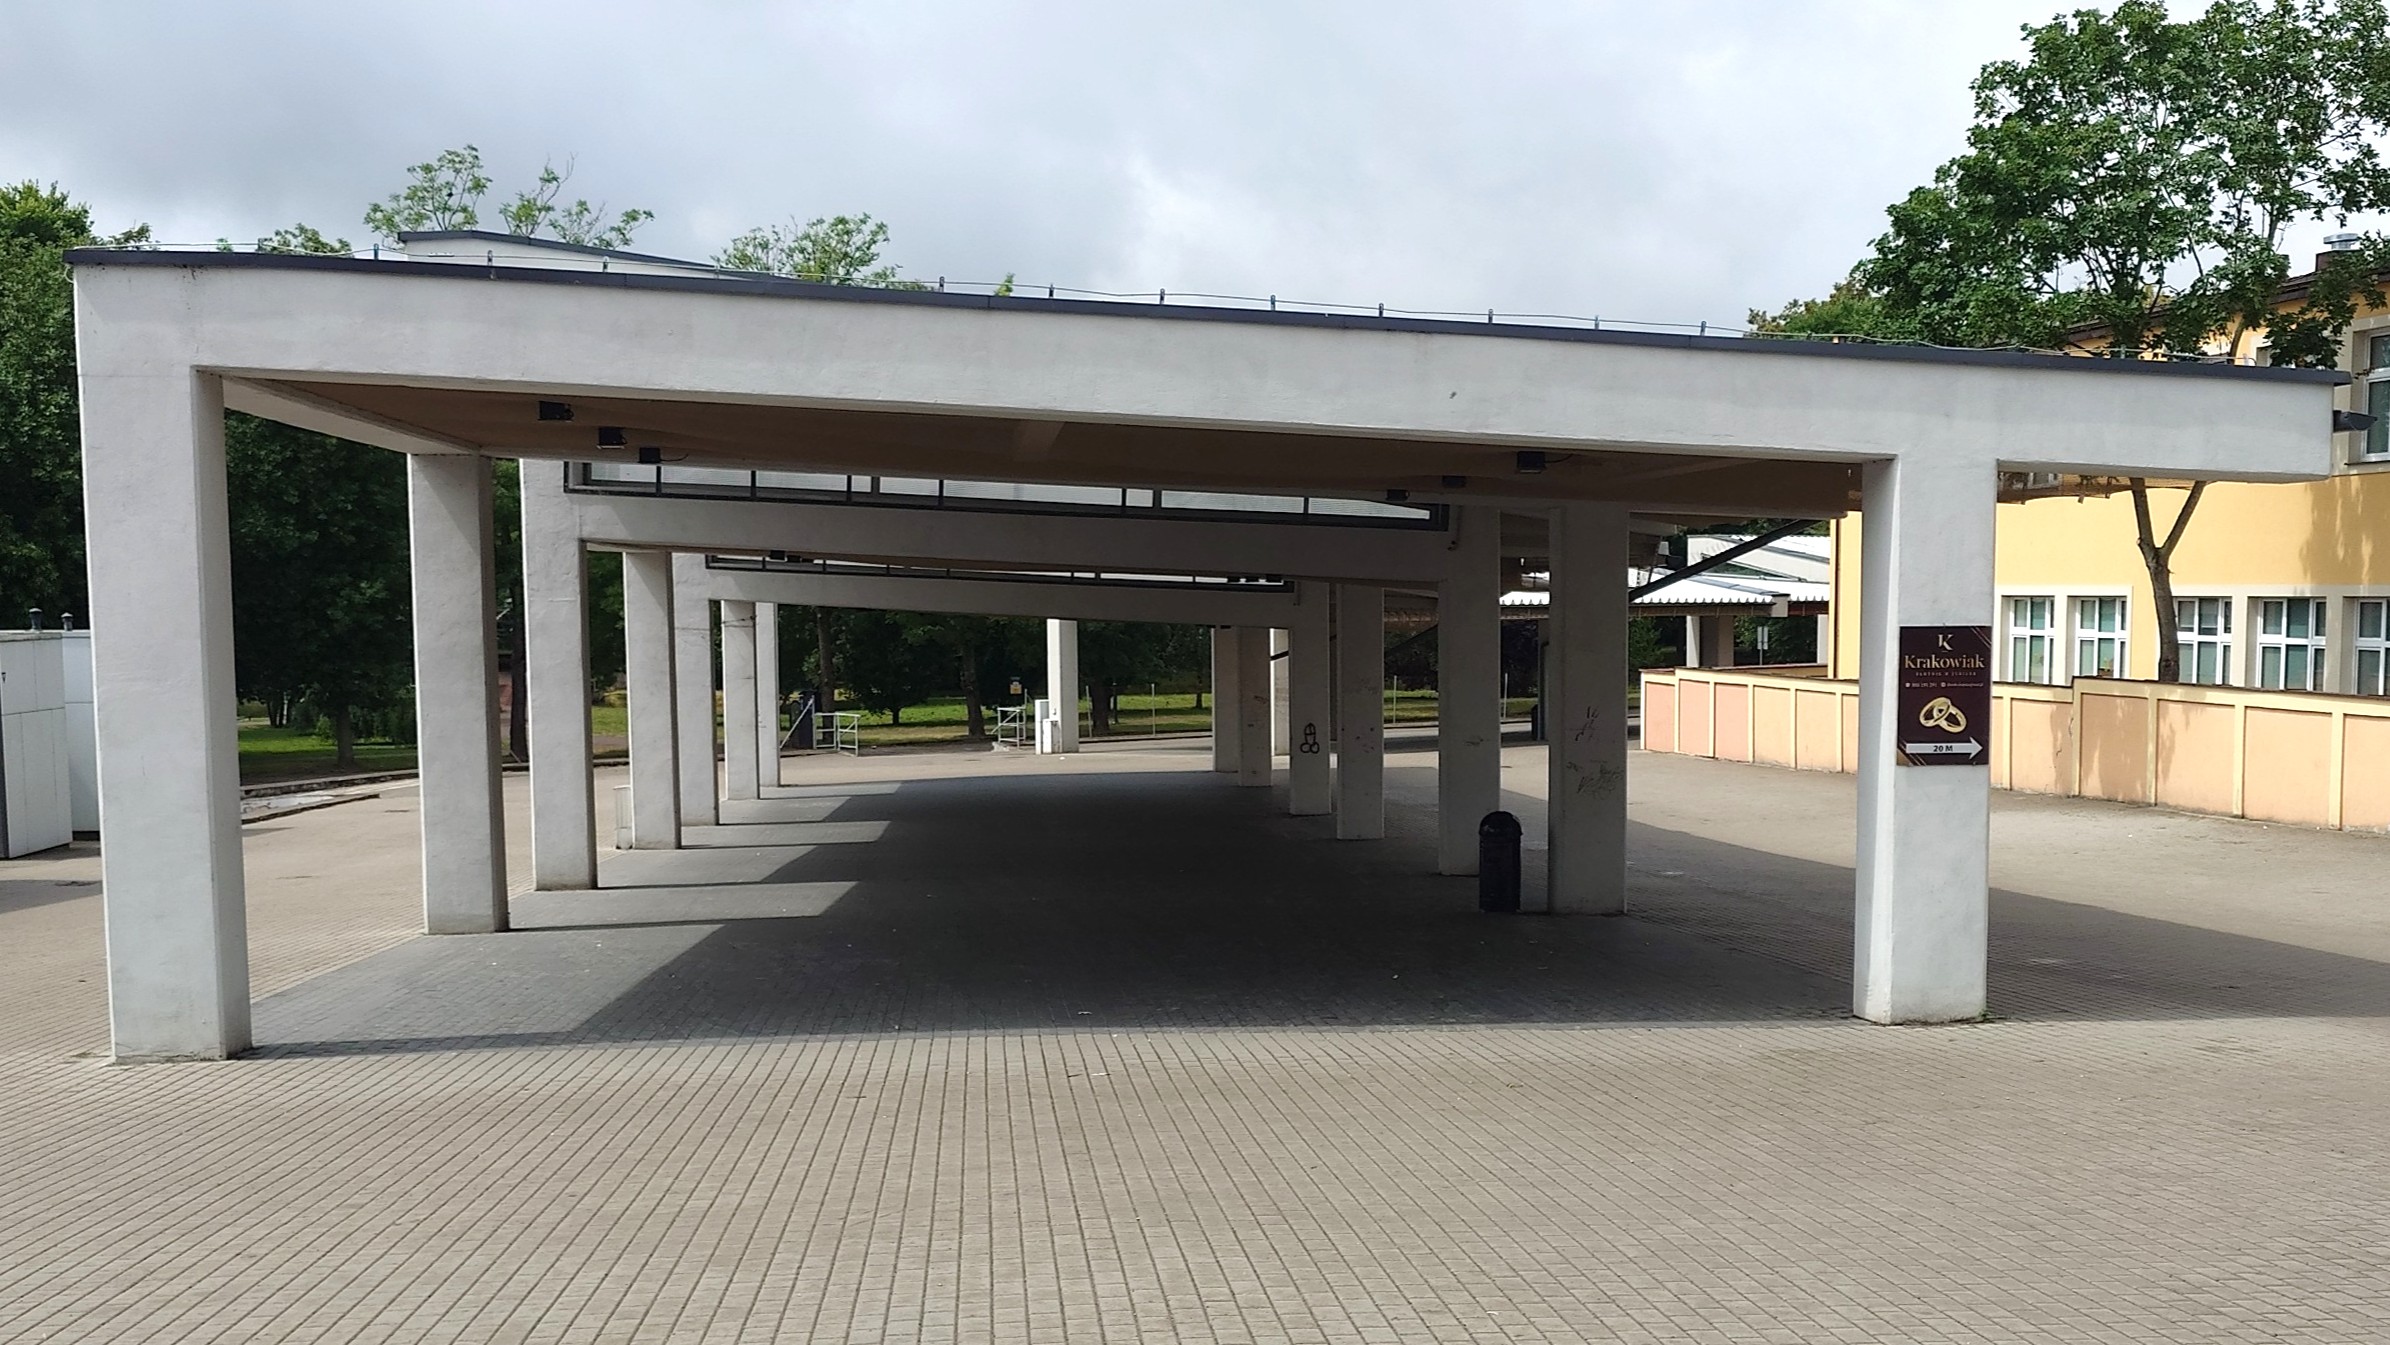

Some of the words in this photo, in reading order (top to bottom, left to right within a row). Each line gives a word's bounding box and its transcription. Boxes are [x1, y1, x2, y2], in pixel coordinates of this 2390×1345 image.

[1938, 634, 1954, 651] K
[1904, 654, 1985, 669] Krakowiak
[1933, 745, 1943, 753] 20
